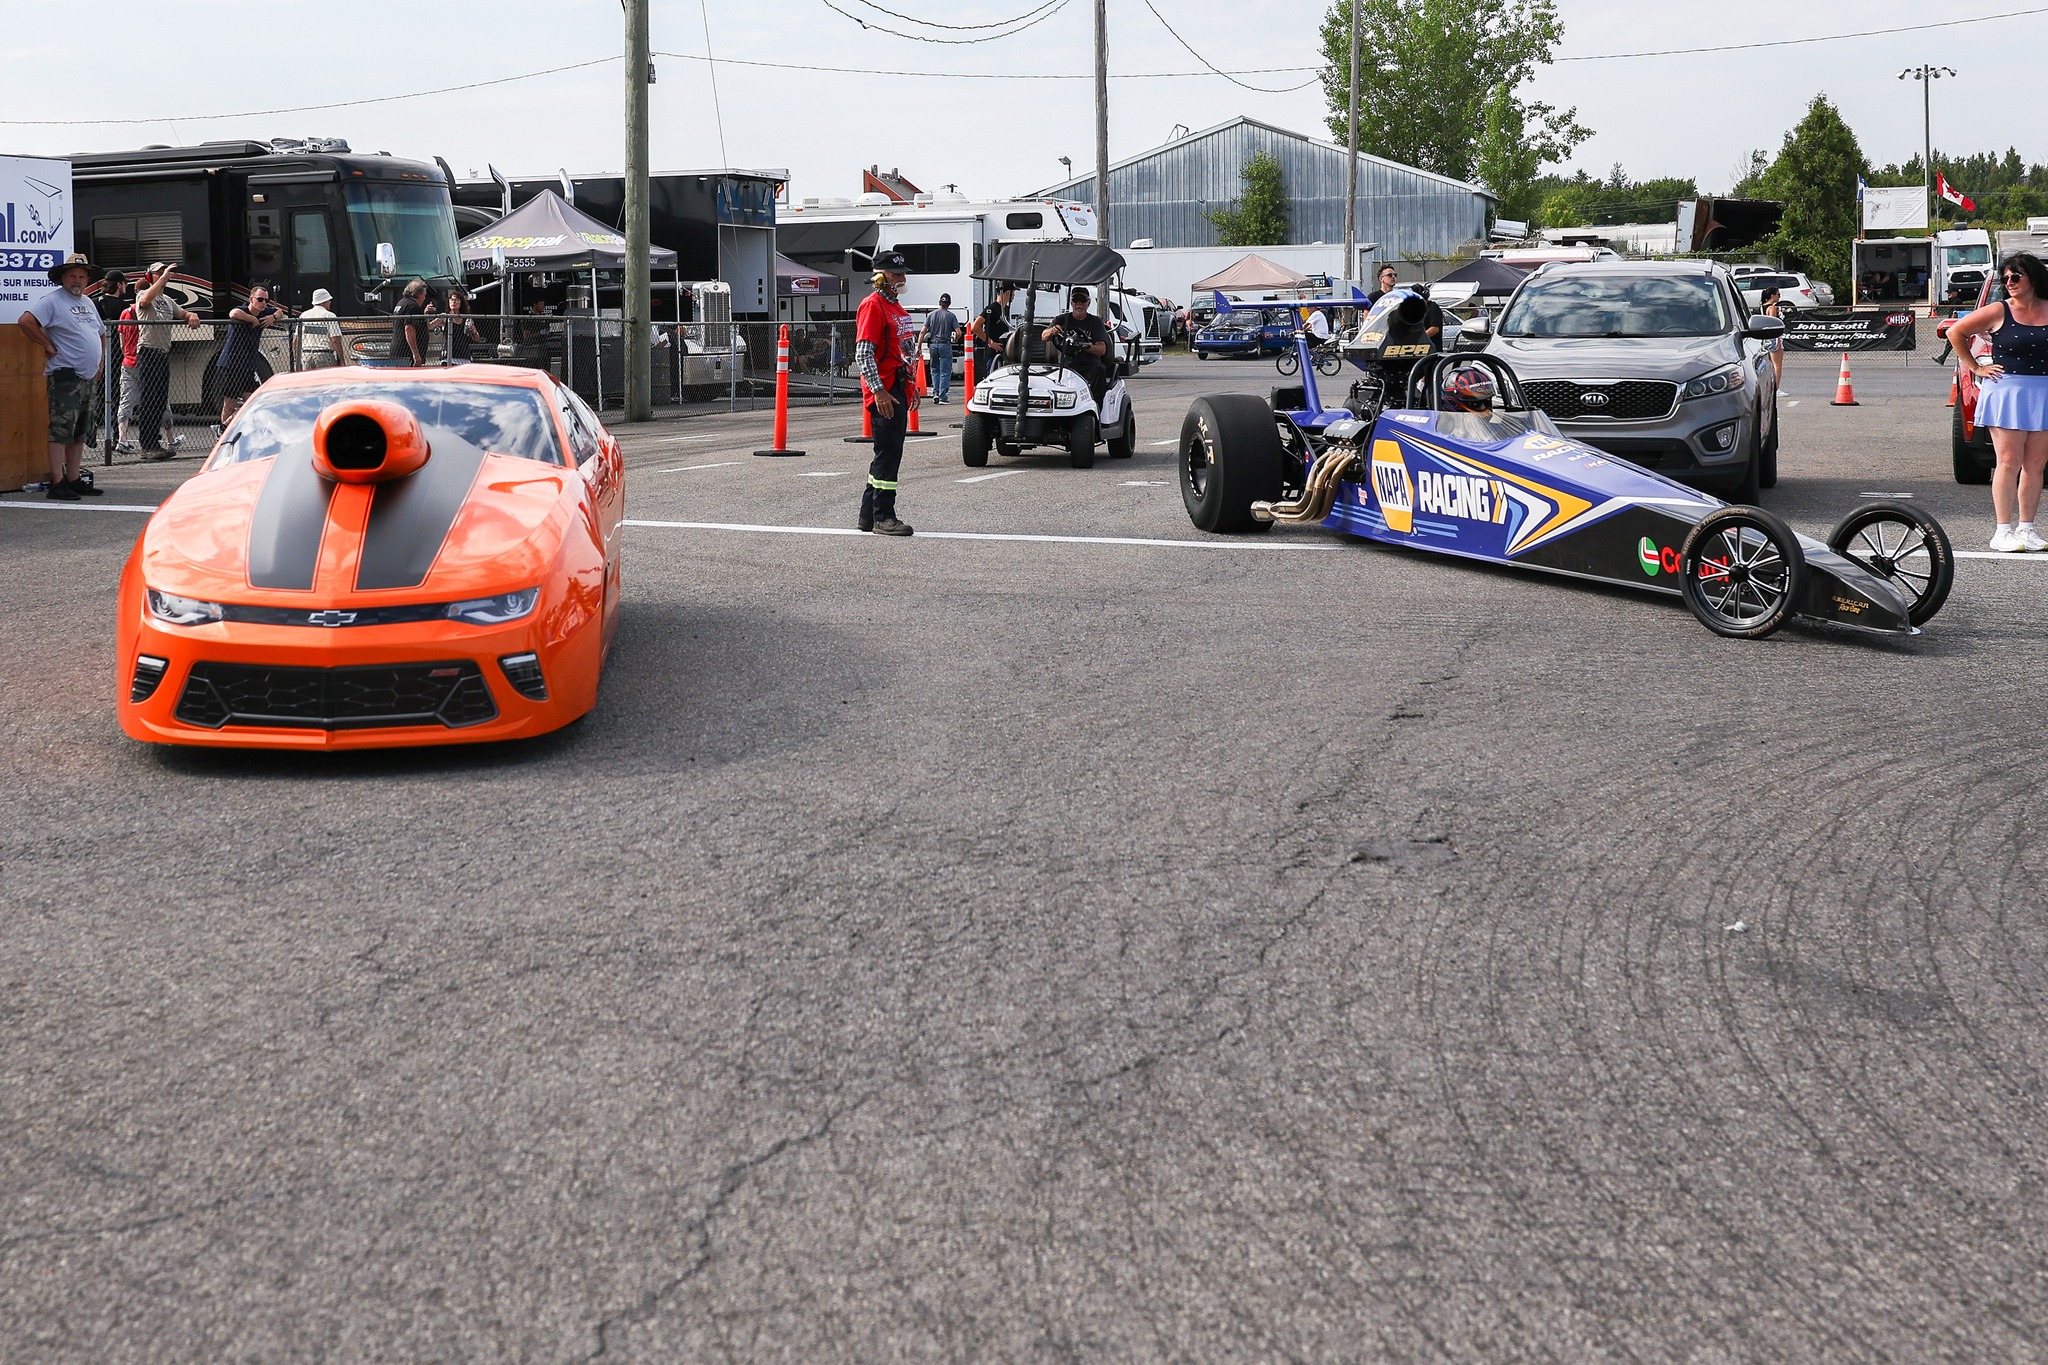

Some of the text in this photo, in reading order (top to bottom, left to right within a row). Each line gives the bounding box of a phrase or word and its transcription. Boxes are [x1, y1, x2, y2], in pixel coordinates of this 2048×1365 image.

[483, 234, 568, 250] Racepak
[466, 259, 490, 270] (949)
[3, 278, 22, 287] SUR
[23, 278, 60, 287] MESUR
[1829, 322, 1869, 330] Scotti
[1889, 315, 1910, 325] NHRA
[1585, 395, 1605, 404] KIA
[1376, 465, 1410, 508] NAPA
[1417, 470, 1491, 523] RACING
[1682, 507, 1749, 556] MICKEY THOMPSON
[1931, 534, 1947, 566] FRONT
